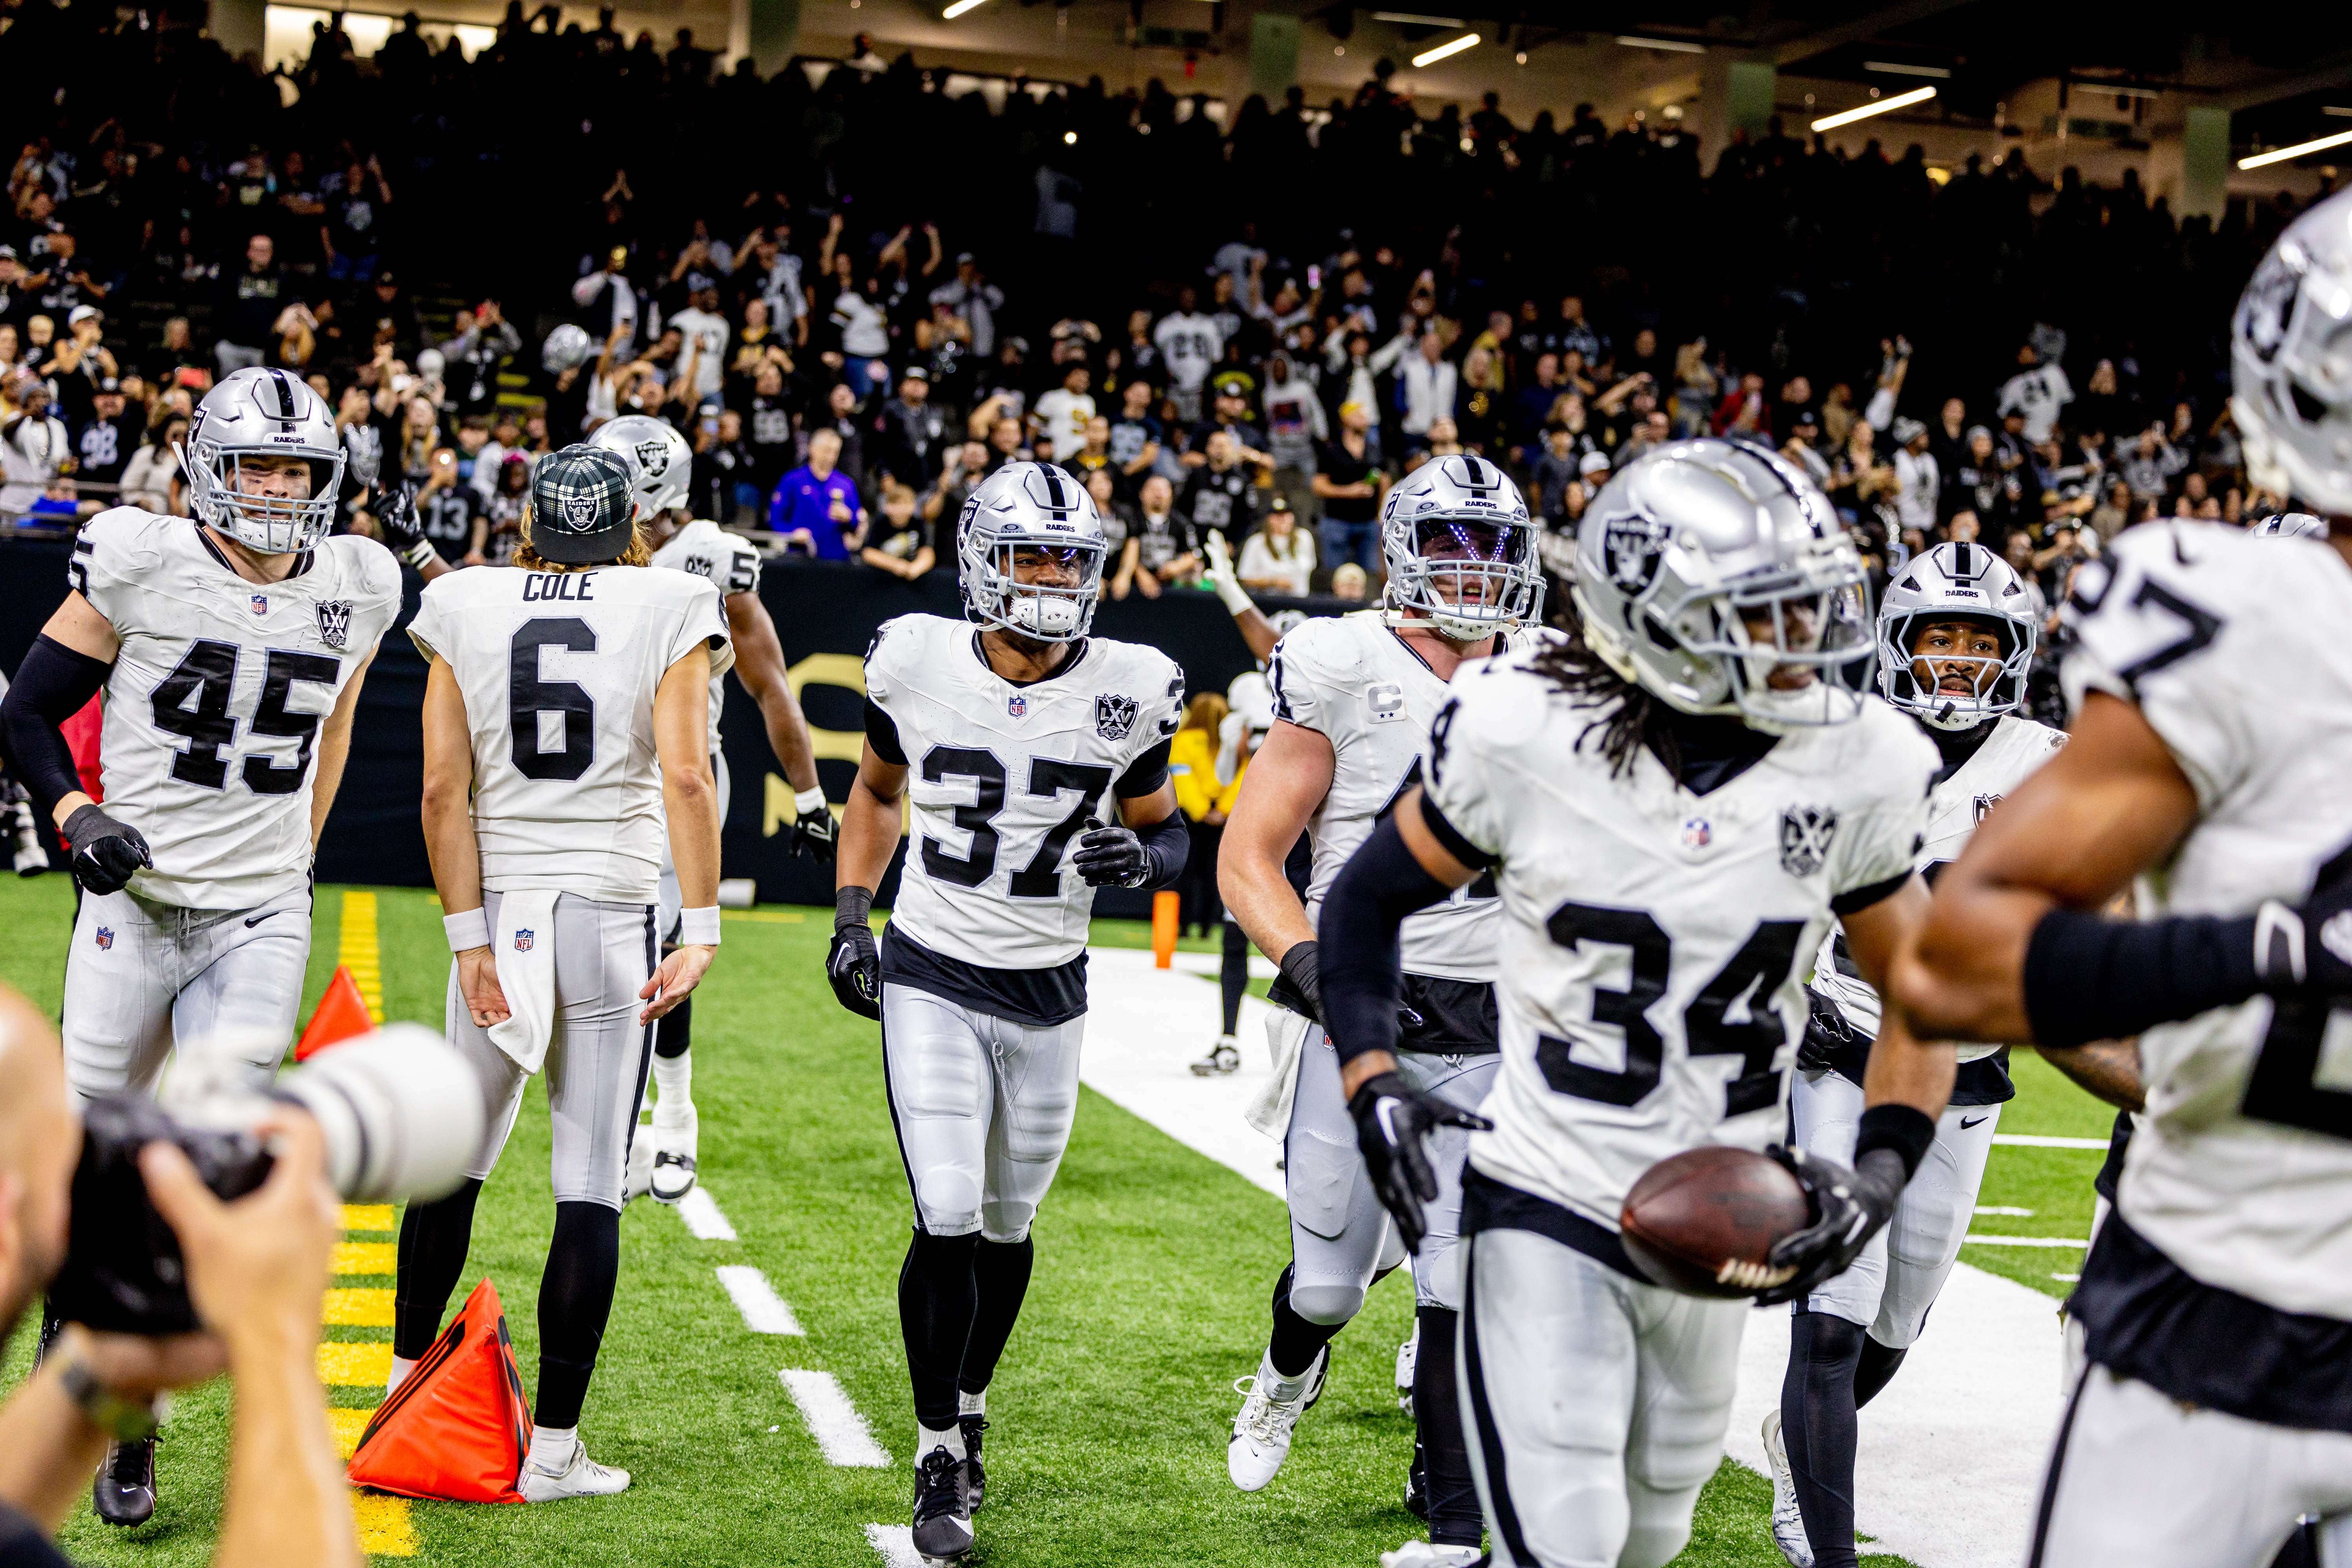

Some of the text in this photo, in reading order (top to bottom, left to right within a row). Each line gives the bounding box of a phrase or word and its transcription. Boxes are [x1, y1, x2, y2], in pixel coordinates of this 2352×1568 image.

[1465, 501, 1497, 509] RAIDERS
[427, 495, 469, 540] 13
[1046, 524, 1075, 533] RAIDERS
[522, 572, 599, 602] COLE
[1945, 590, 1978, 598] RAIDERS
[253, 603, 266, 612] NFL
[322, 613, 348, 629] LXV
[507, 615, 599, 782] 6
[1367, 684, 1402, 712] C
[148, 637, 343, 797] 45
[1011, 705, 1024, 715] NFL
[1100, 707, 1133, 723] LXV
[919, 743, 1115, 900] 37
[98, 936, 109, 946] NFL
[516, 939, 531, 950] NFL
[1535, 902, 1806, 1118] 34
